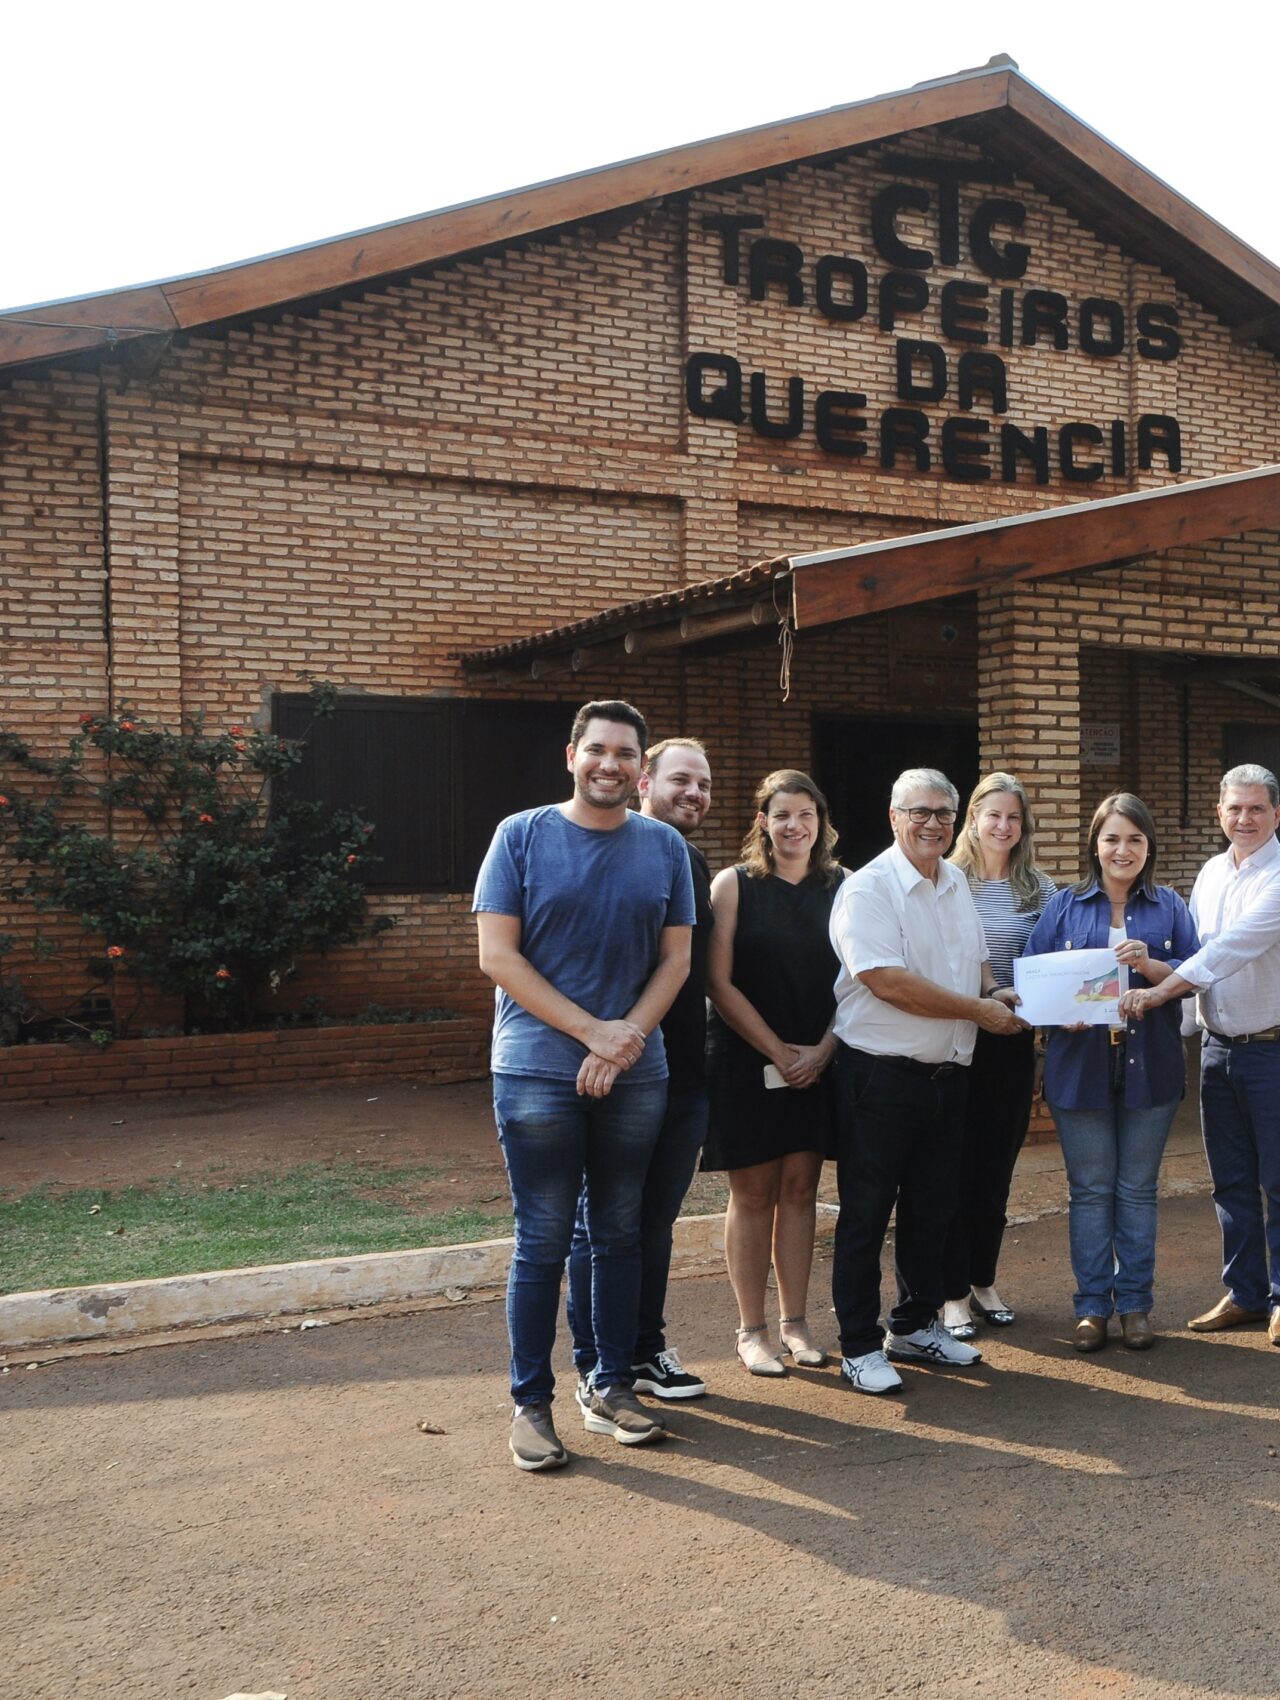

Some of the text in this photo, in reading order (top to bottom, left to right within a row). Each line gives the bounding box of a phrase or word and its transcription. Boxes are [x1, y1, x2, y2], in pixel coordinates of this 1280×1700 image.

[871, 155, 1031, 279] CTG
[701, 214, 1181, 361] TROPEIROS
[686, 351, 1182, 484] QUERENCIA
[896, 339, 1007, 414] DA
